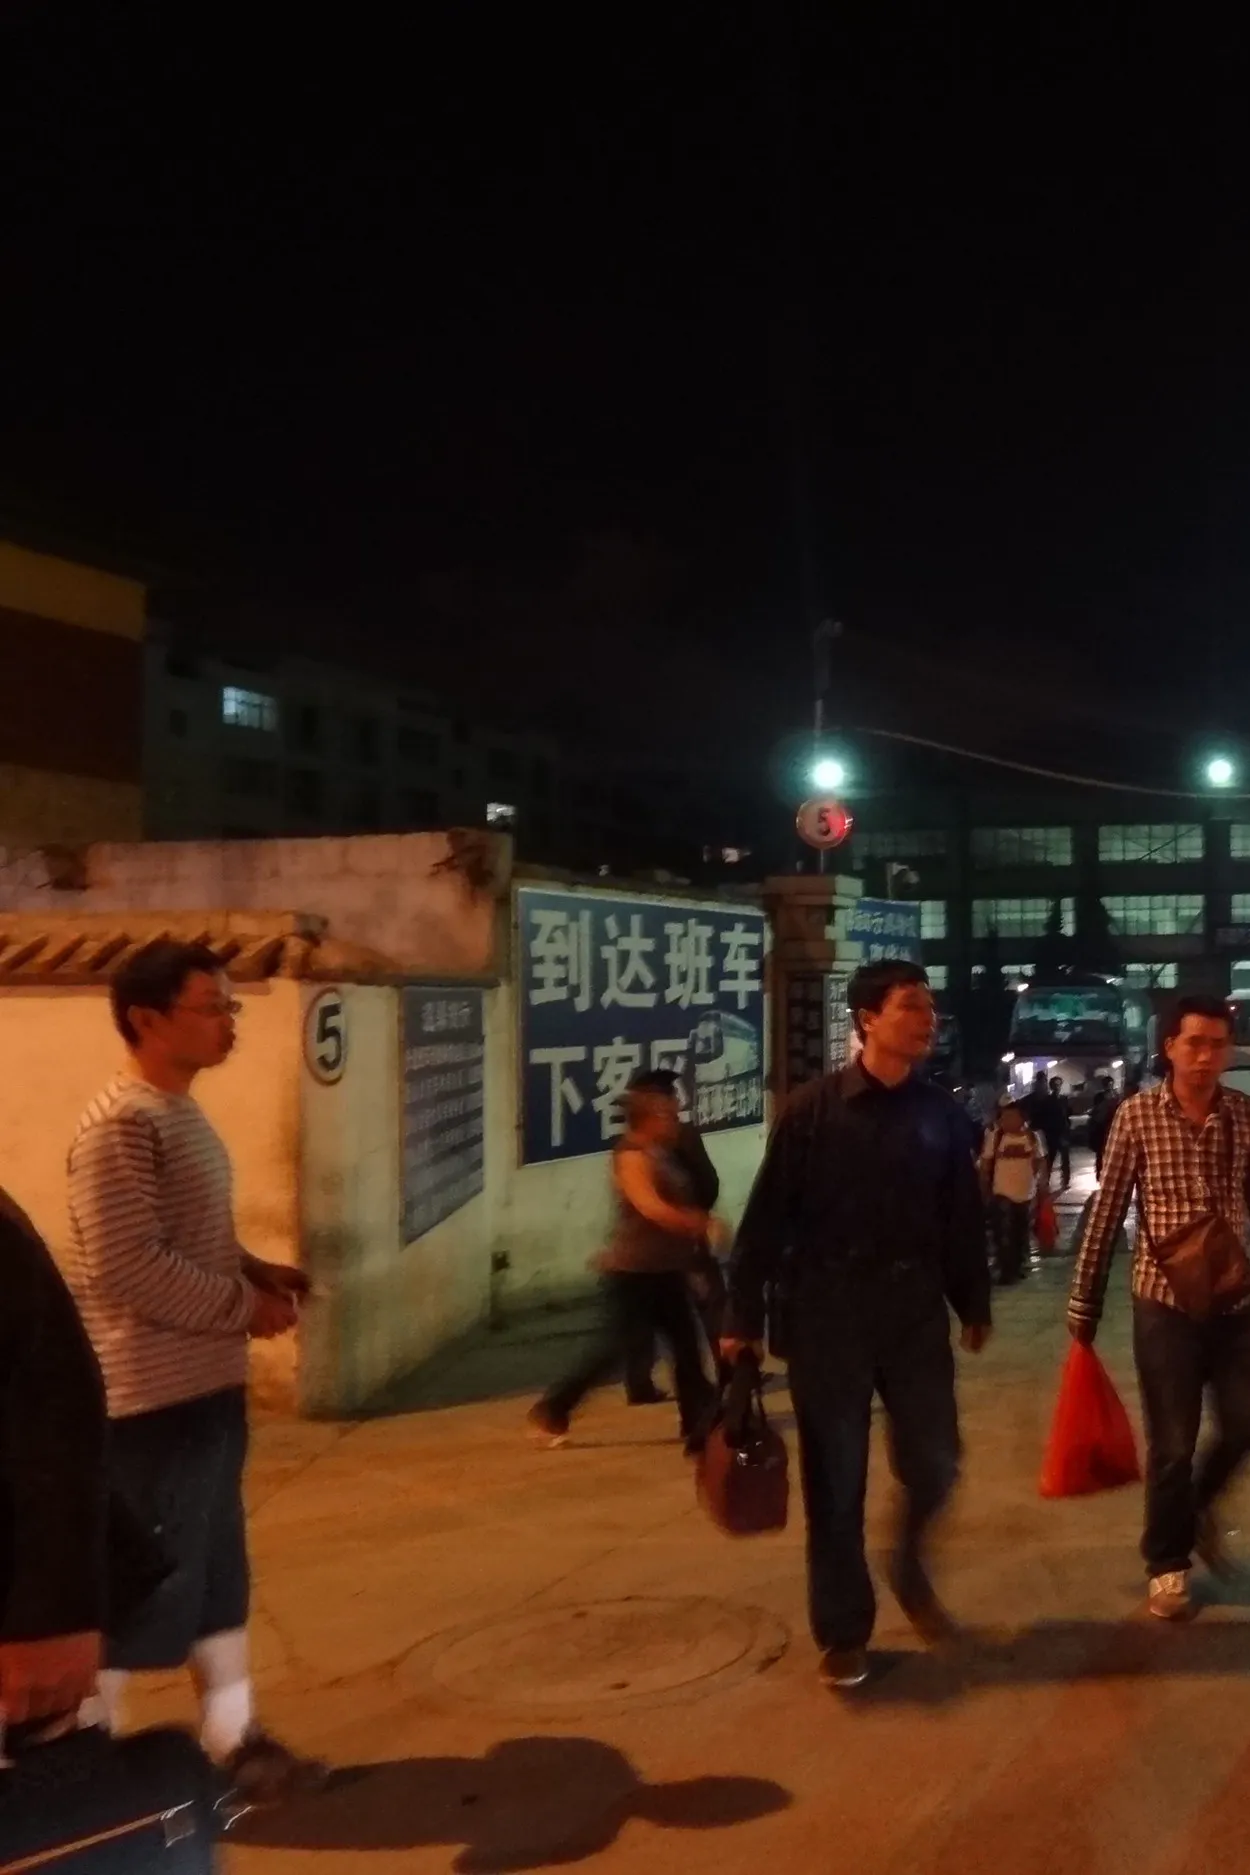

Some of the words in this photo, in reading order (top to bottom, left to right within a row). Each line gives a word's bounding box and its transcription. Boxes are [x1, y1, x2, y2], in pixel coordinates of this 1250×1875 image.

[529, 908, 762, 1013] 到达班车
[316, 1002, 342, 1072] 5
